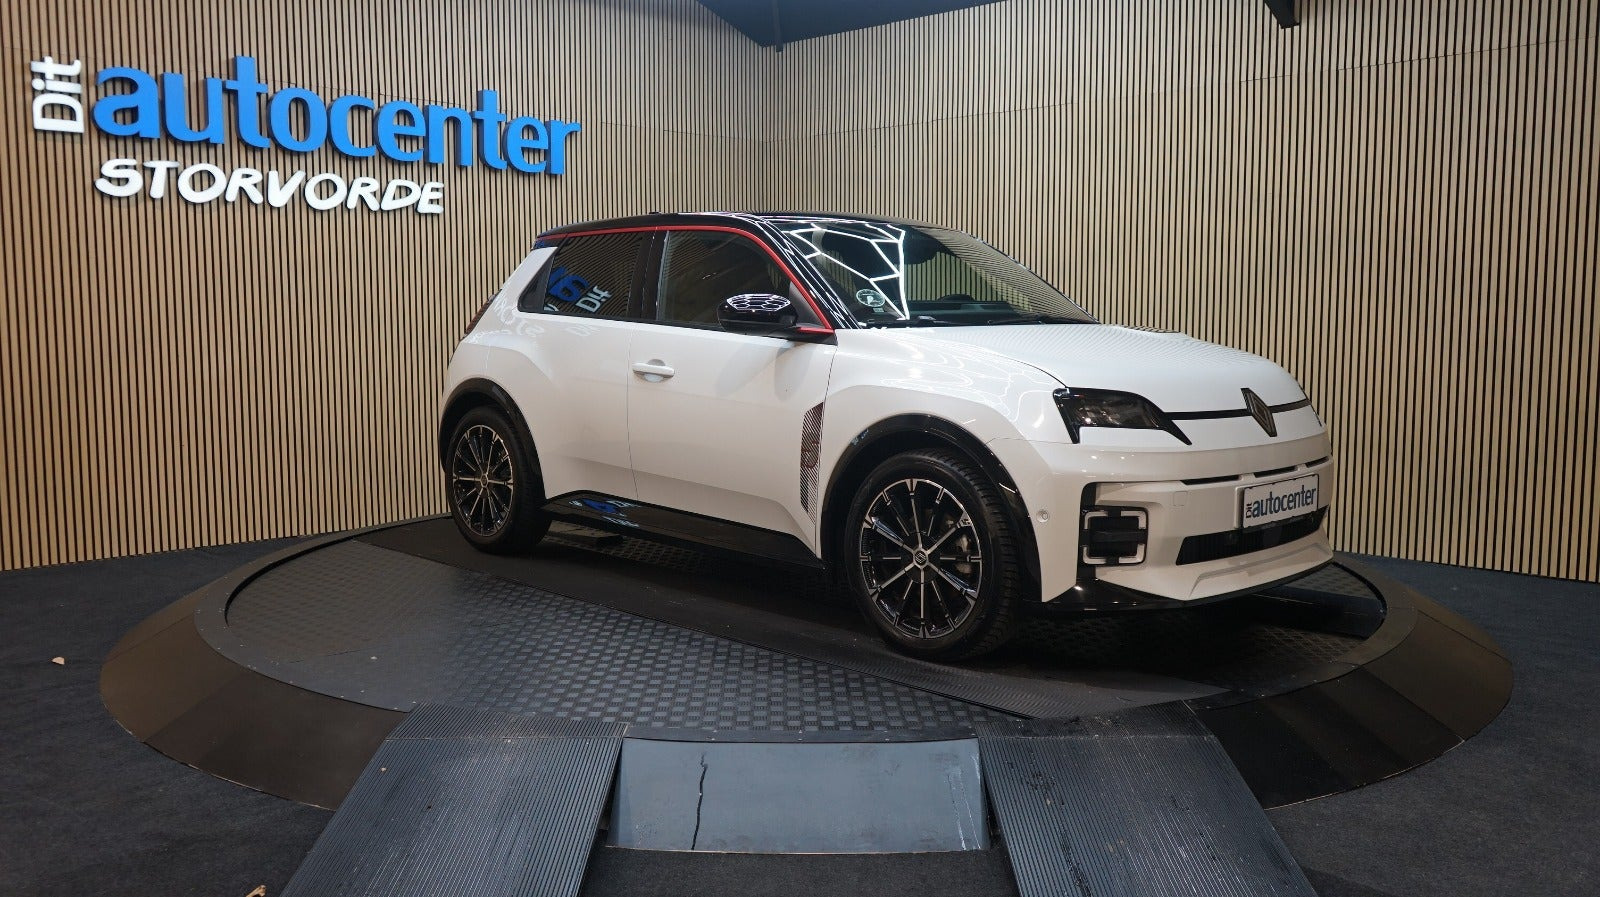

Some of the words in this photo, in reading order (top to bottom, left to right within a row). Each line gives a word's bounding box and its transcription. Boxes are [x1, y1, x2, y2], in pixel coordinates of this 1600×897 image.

[31, 56, 84, 134] Dit
[93, 55, 581, 175] autocenter
[95, 158, 444, 213] STORVORDE
[1252, 485, 1316, 517] autocenter
